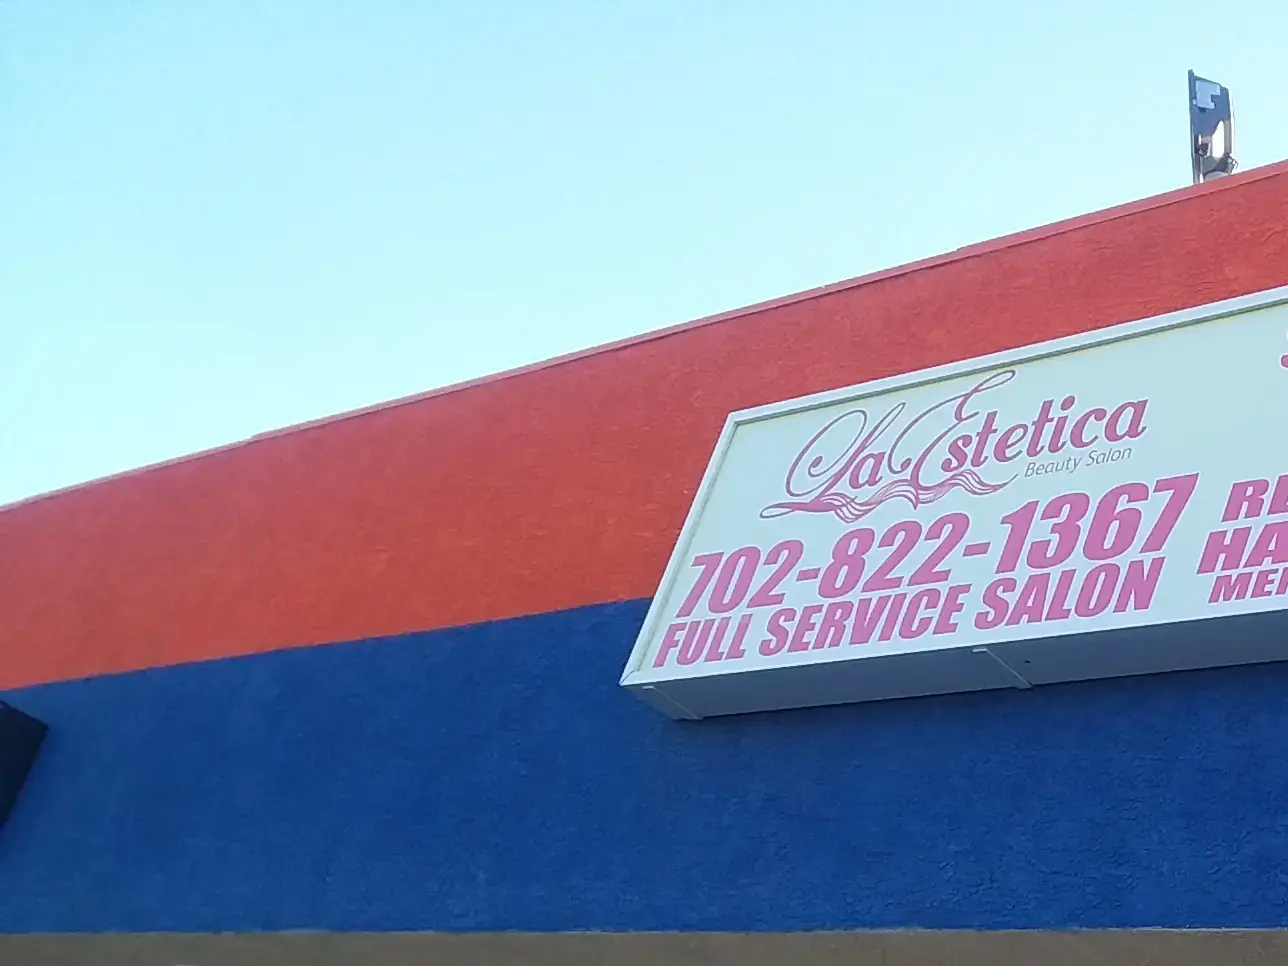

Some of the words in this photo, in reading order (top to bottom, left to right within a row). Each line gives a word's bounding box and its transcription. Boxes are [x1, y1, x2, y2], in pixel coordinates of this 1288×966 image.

[760, 402, 906, 518] La
[887, 369, 1150, 495] Estetica
[1024, 452, 1083, 479] Beauty
[1085, 446, 1133, 468] Salon
[675, 473, 1200, 618] 702-822-1367
[652, 613, 753, 668] FULL
[758, 584, 973, 656] SERVICE
[973, 556, 1167, 630] SALON
